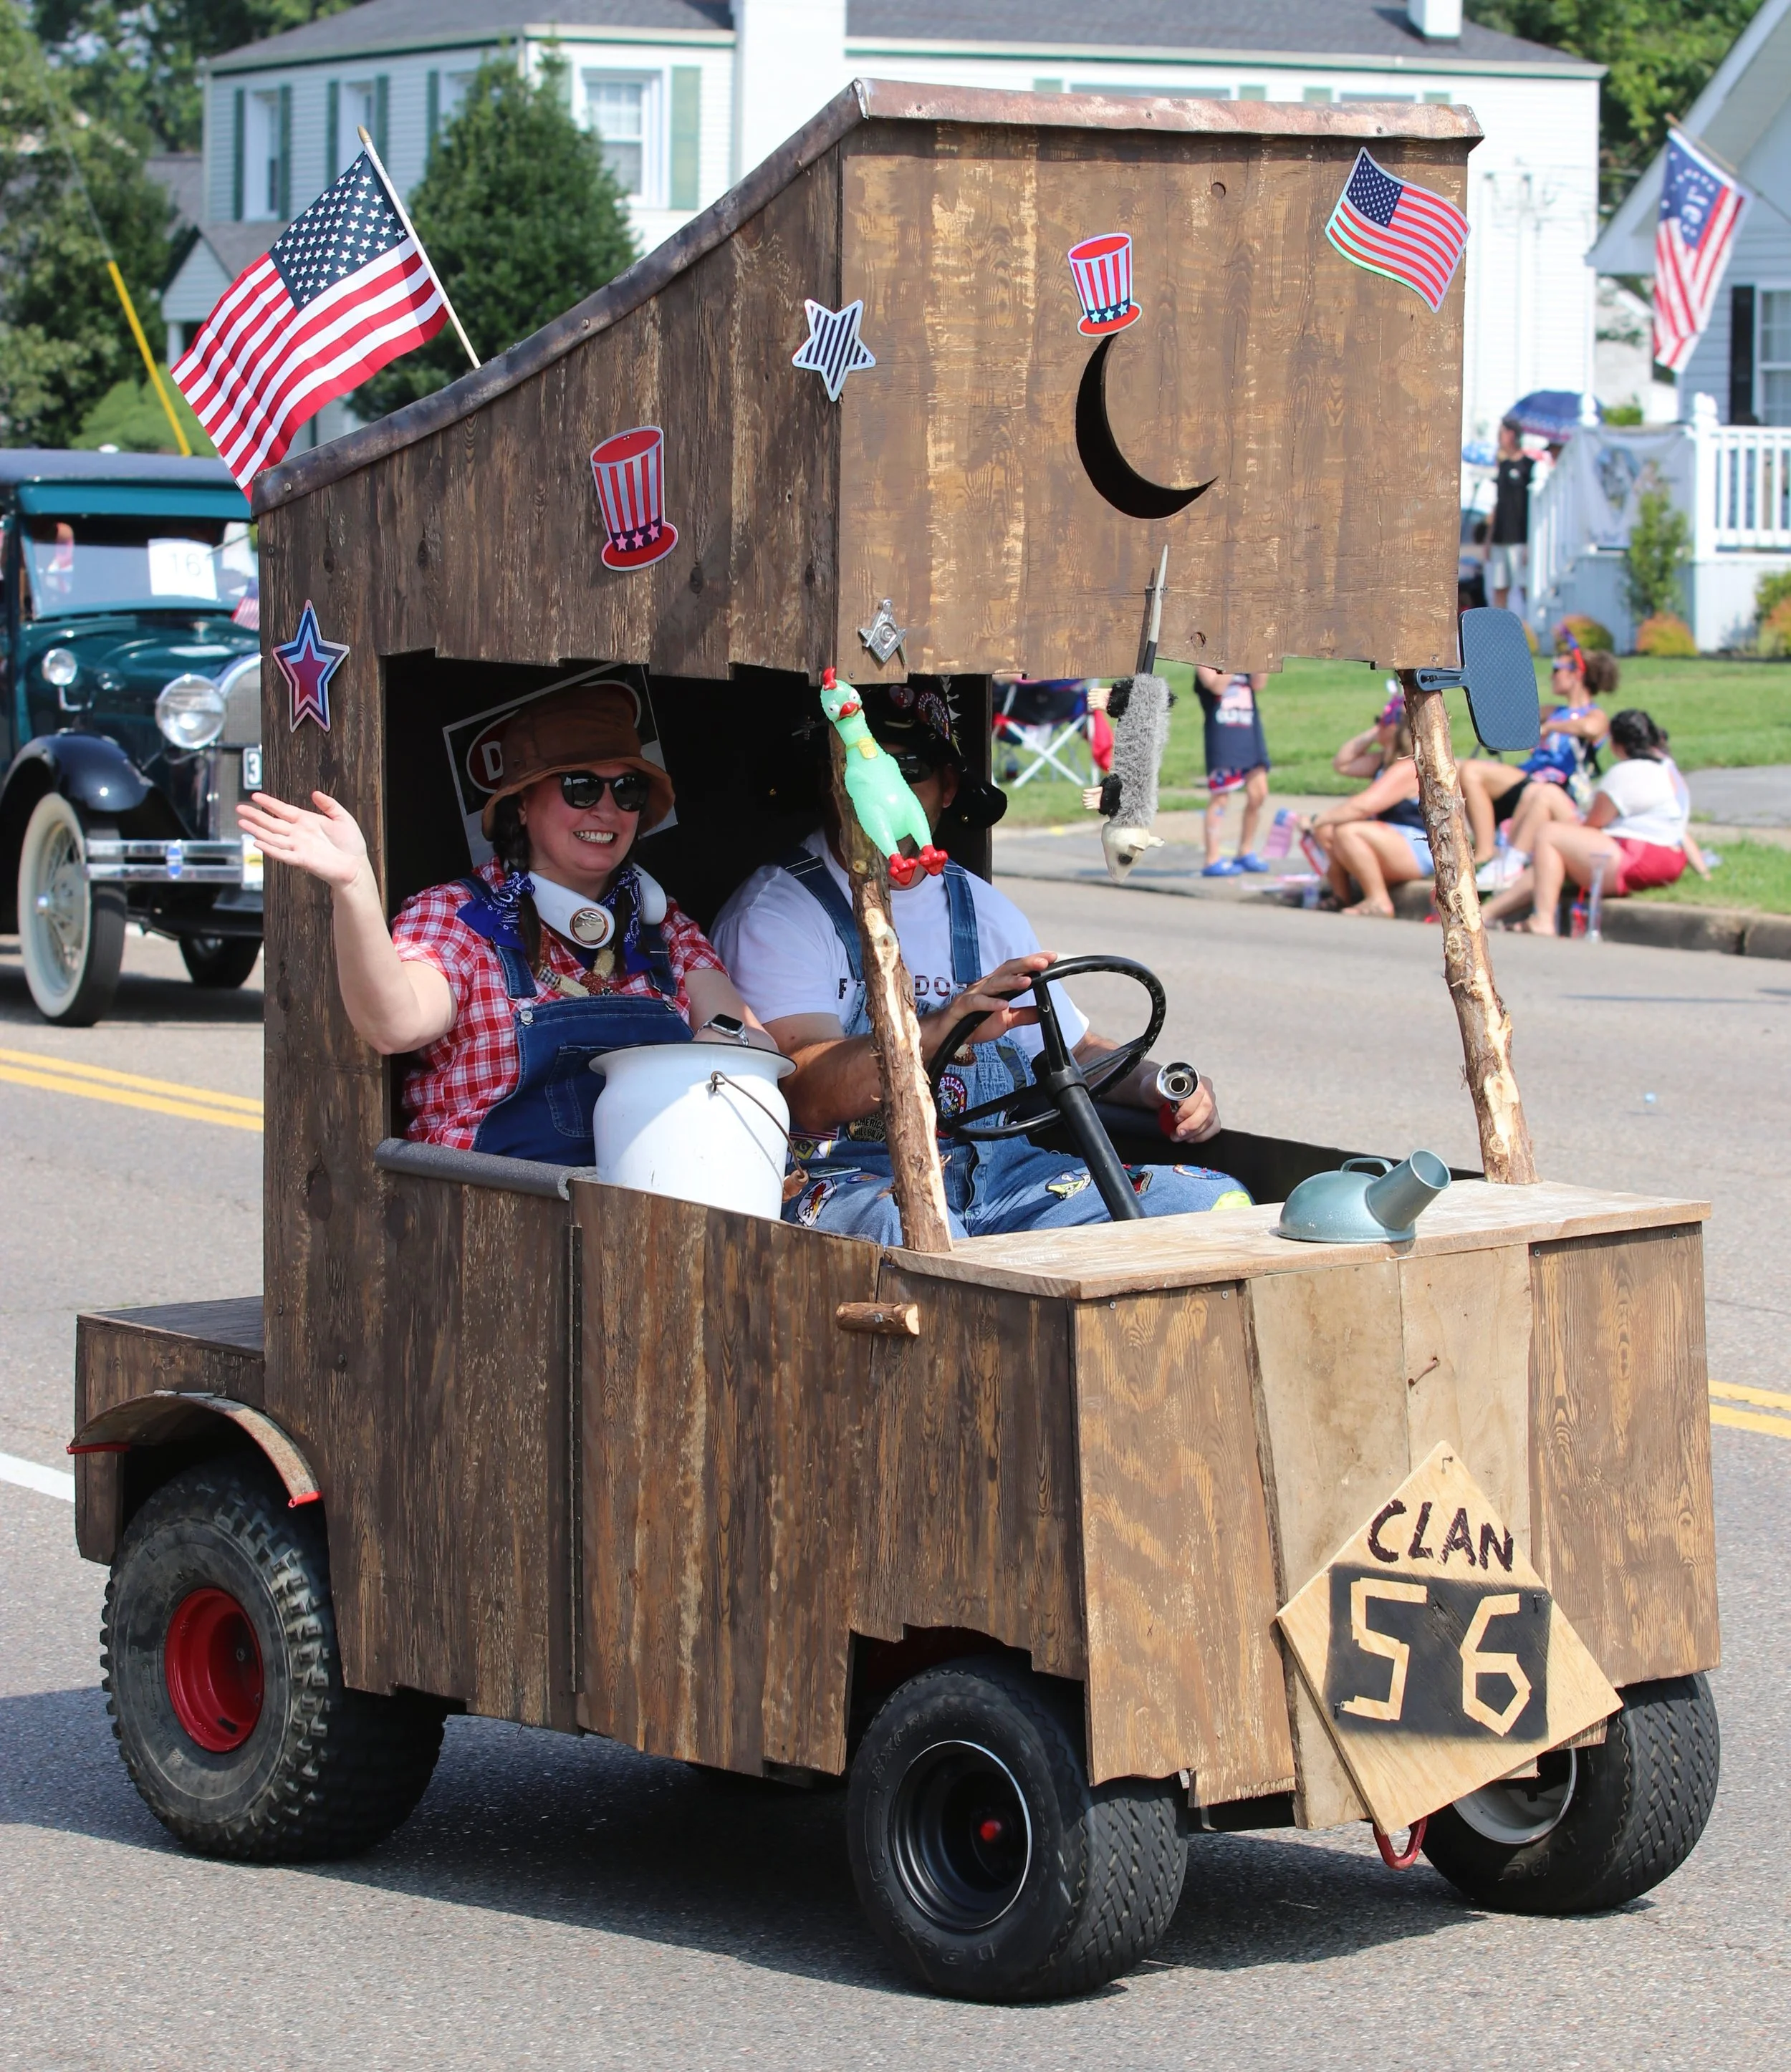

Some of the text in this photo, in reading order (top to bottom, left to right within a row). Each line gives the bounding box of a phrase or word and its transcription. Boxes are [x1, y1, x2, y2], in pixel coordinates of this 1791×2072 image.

[169, 551, 201, 577] 16
[1367, 1498, 1514, 1572] CLAN
[1341, 1577, 1532, 1738] 56
